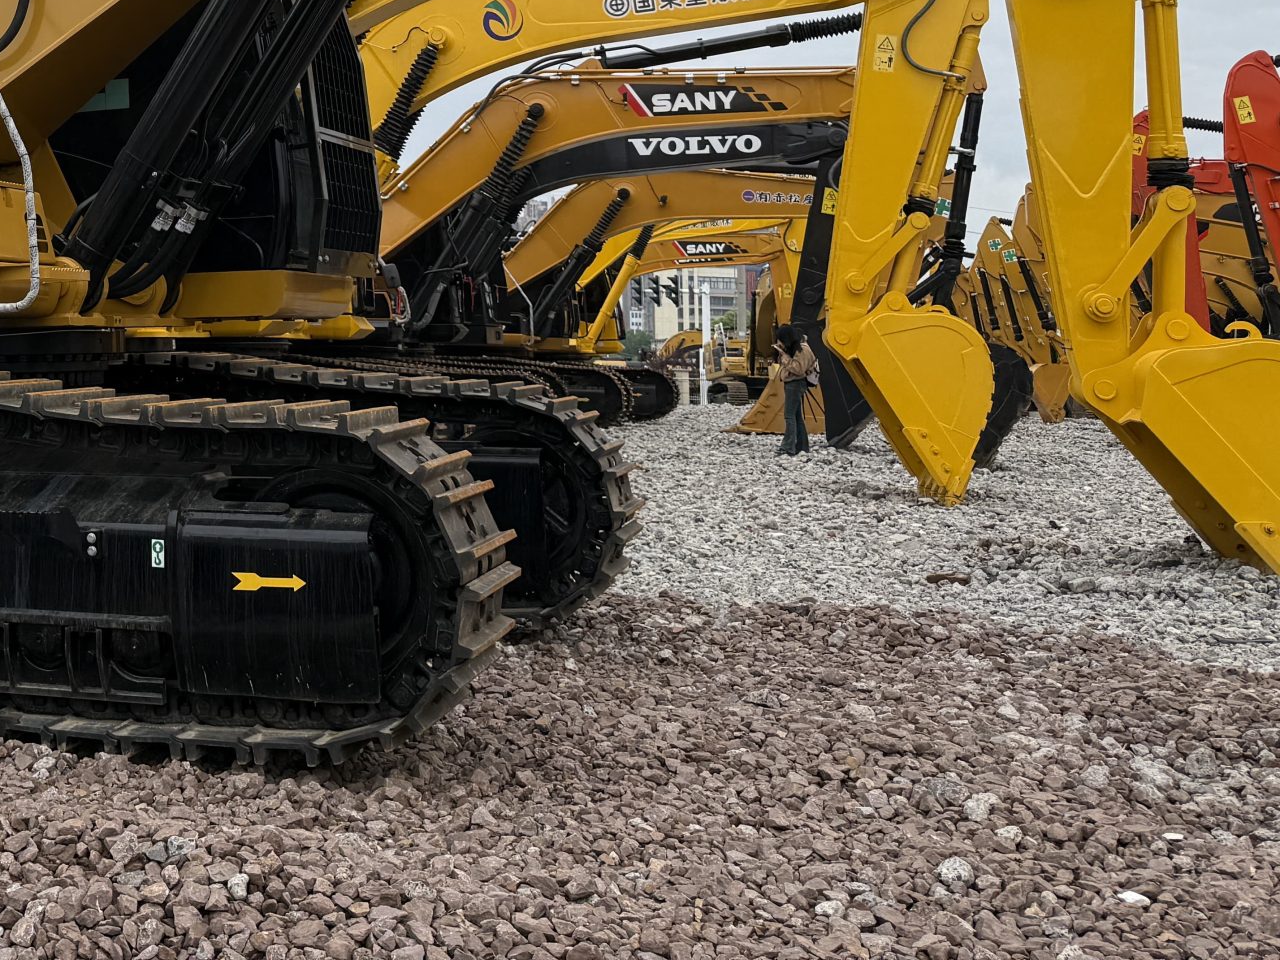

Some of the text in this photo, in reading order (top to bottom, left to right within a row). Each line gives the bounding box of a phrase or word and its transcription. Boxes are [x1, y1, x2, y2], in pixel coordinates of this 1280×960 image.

[652, 90, 737, 113] SANY
[628, 134, 762, 155] VOLVO
[686, 243, 726, 254] SANY
